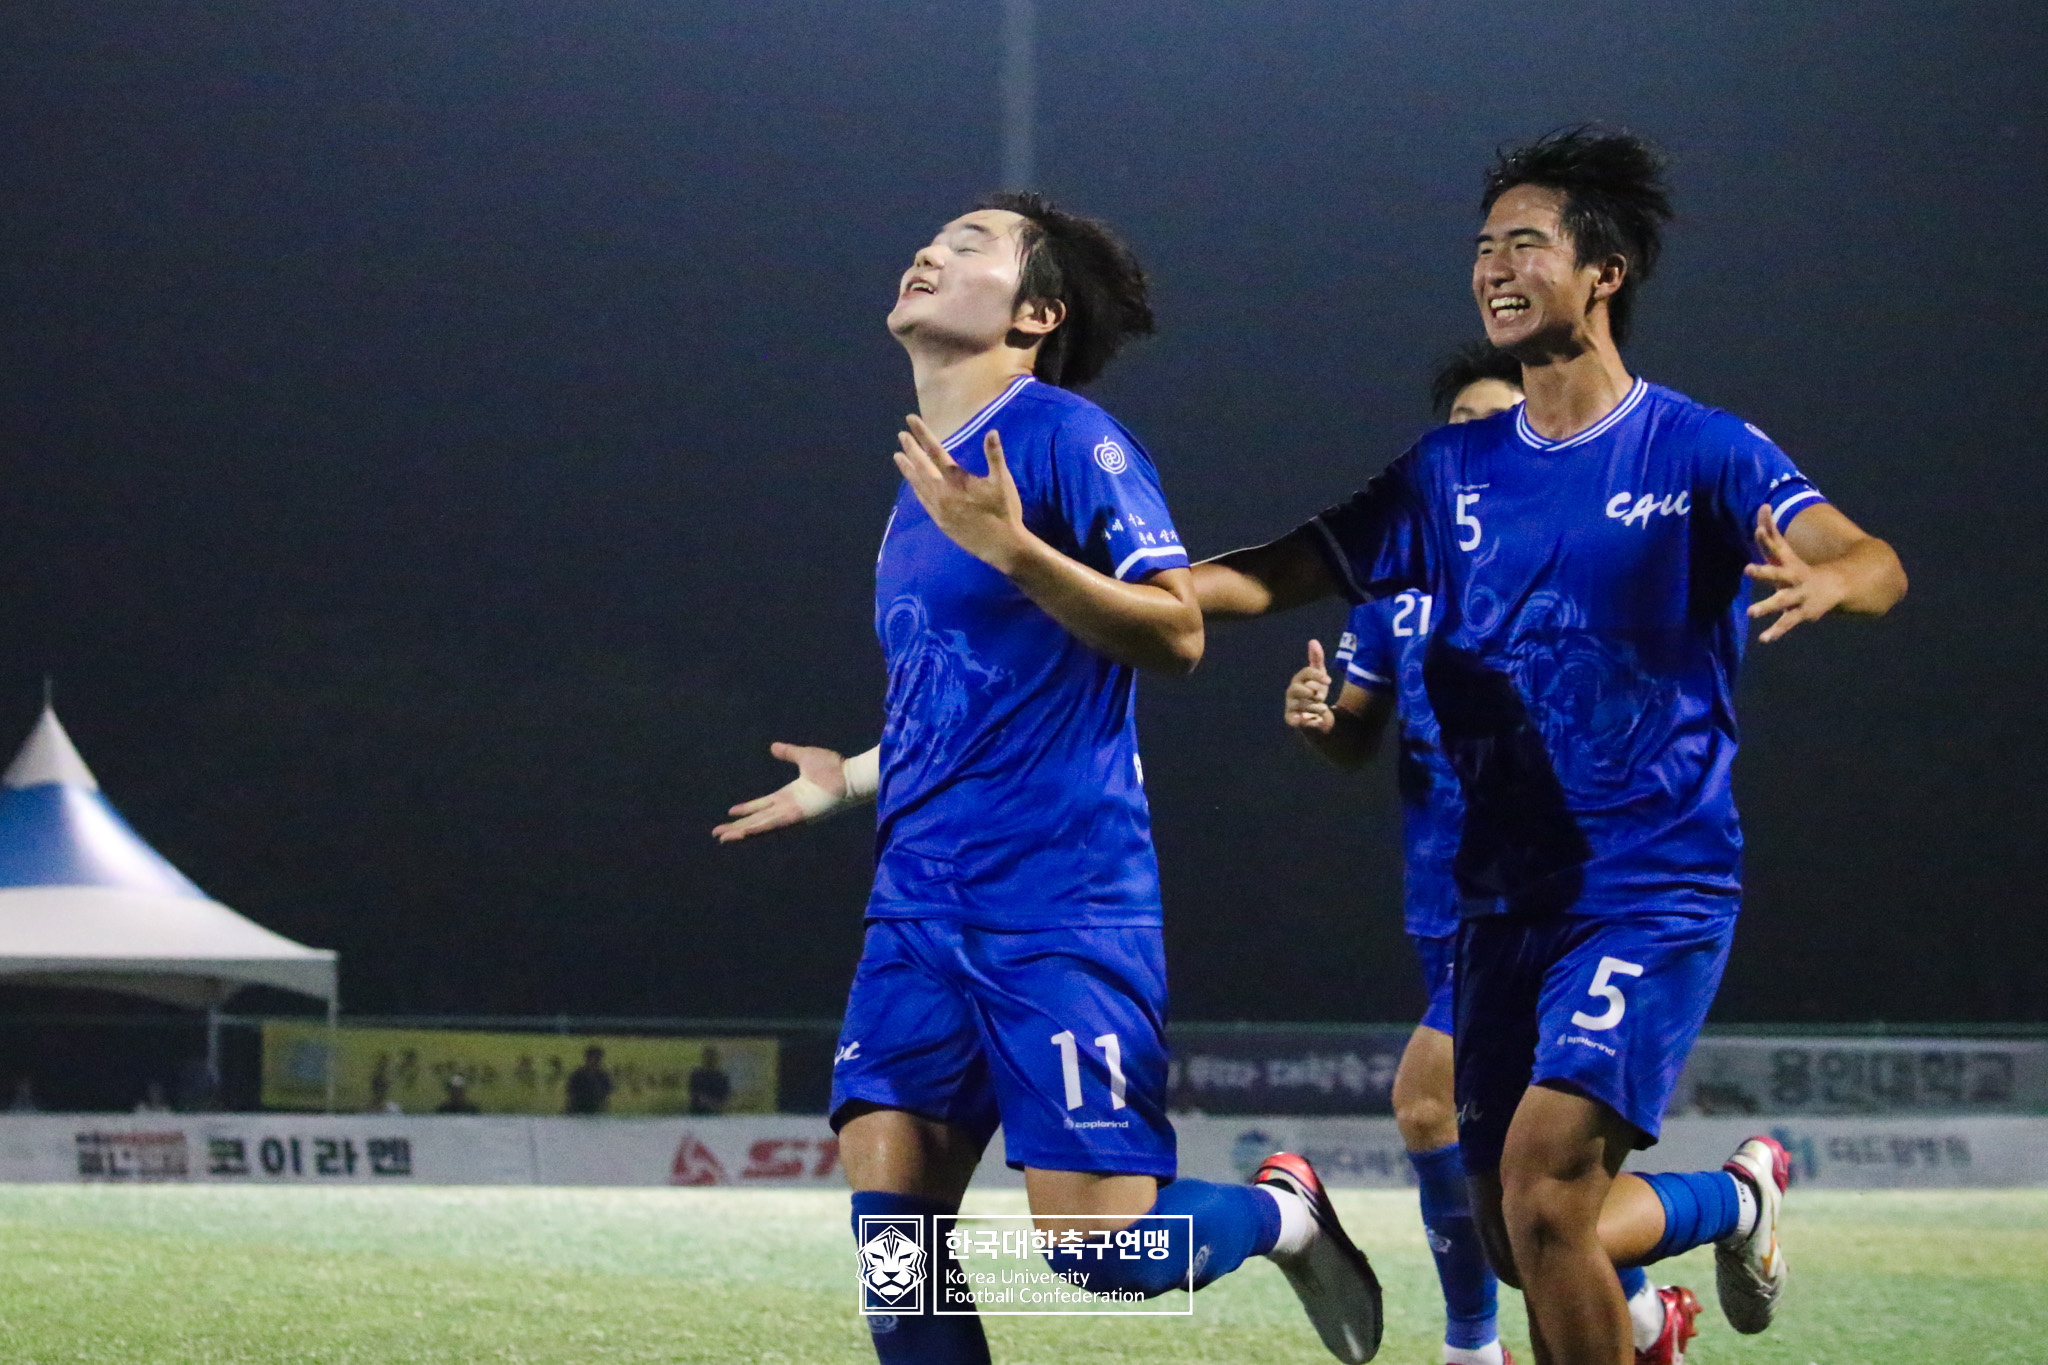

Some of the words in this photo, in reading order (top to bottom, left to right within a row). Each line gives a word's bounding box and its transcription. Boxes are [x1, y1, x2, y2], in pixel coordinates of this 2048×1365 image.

[1456, 493, 1482, 552] 5
[1392, 593, 1432, 637] 21
[1571, 955, 1644, 1031] 5
[1050, 1029, 1127, 1111] 11
[1770, 1047, 2015, 1105] 용인대학교
[1075, 1120, 1129, 1129] applerind
[206, 1135, 413, 1178] 코이라멘
